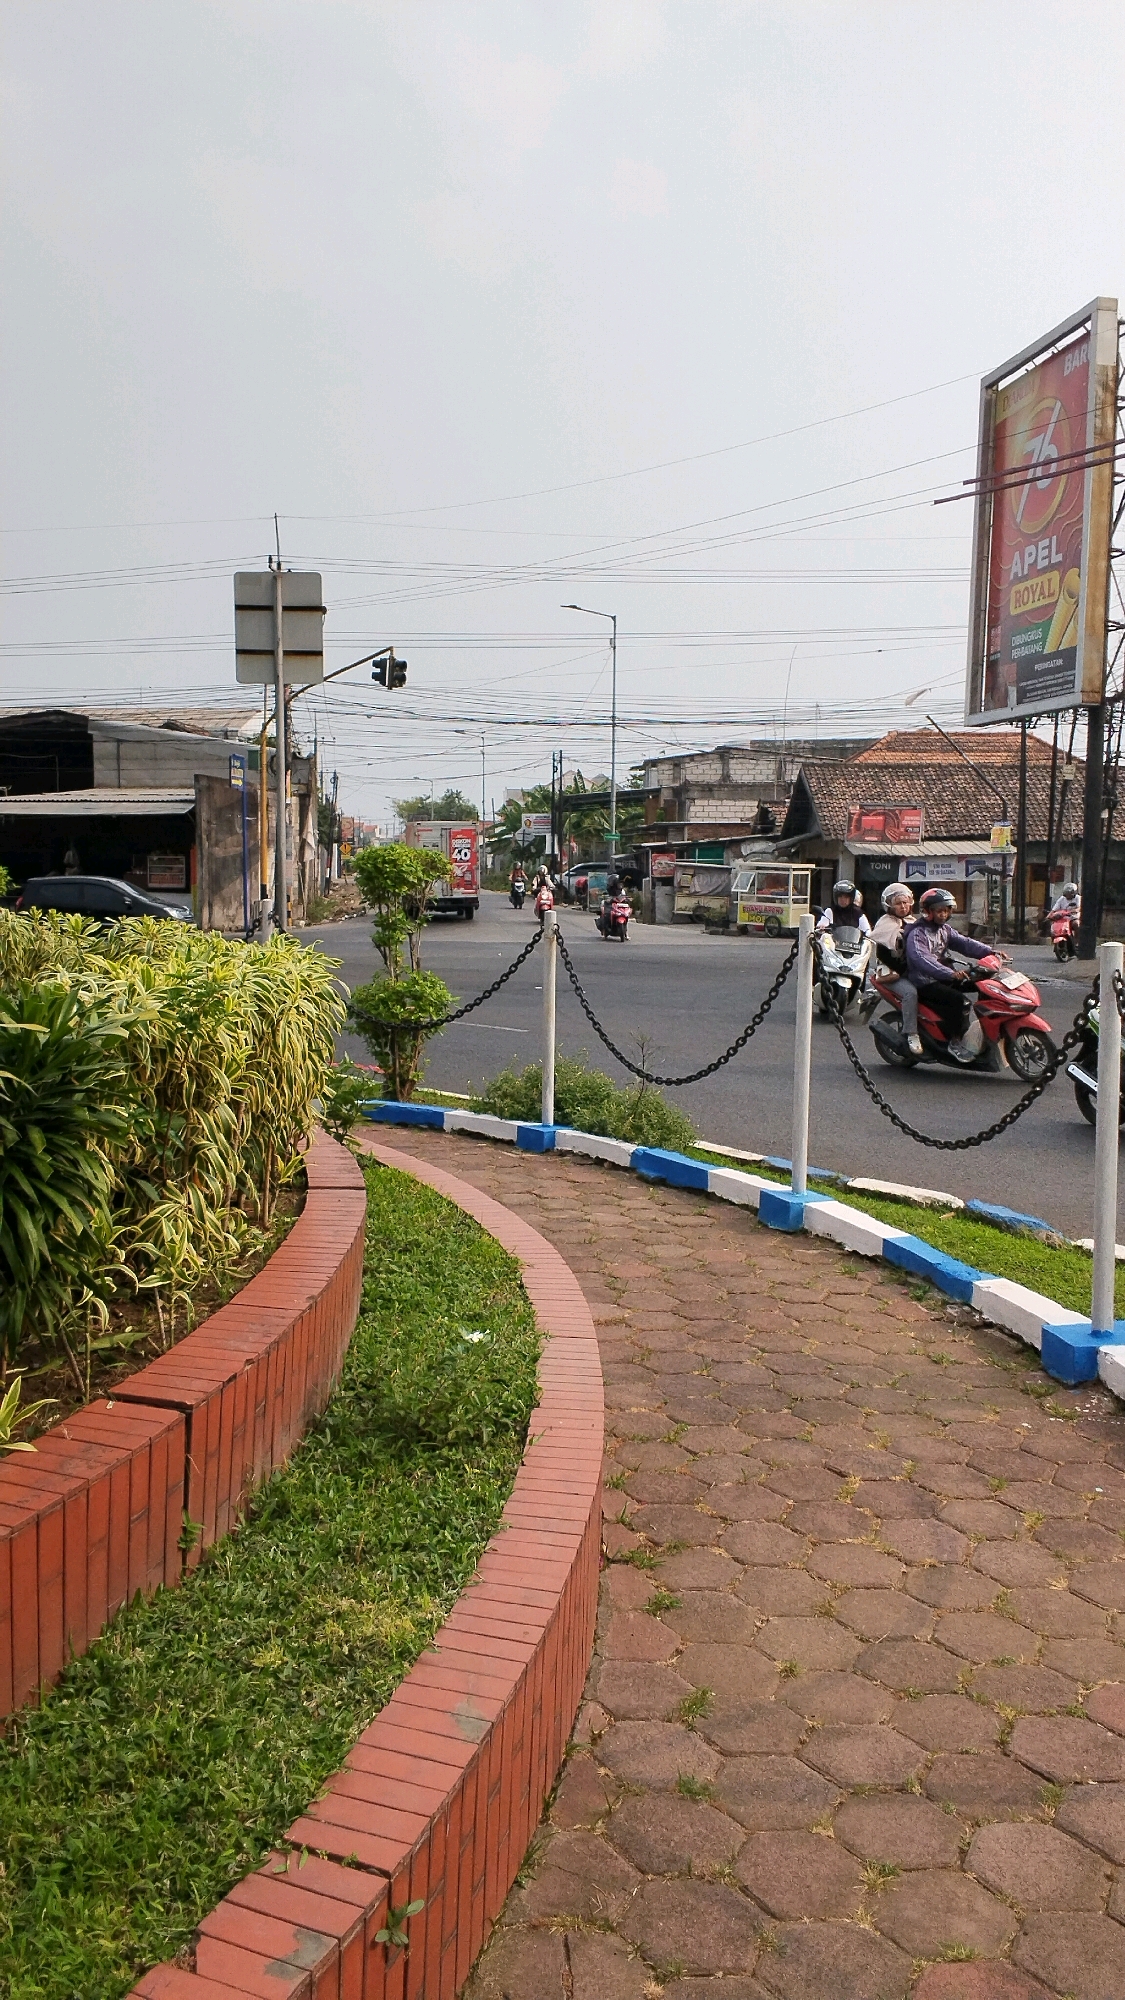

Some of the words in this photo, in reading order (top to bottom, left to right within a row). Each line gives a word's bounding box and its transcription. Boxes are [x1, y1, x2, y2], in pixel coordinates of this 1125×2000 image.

[1009, 535, 1063, 580] APEL
[1013, 576, 1056, 610] ROYAL
[451, 848, 471, 862] 40
[870, 862, 891, 870] TONI
